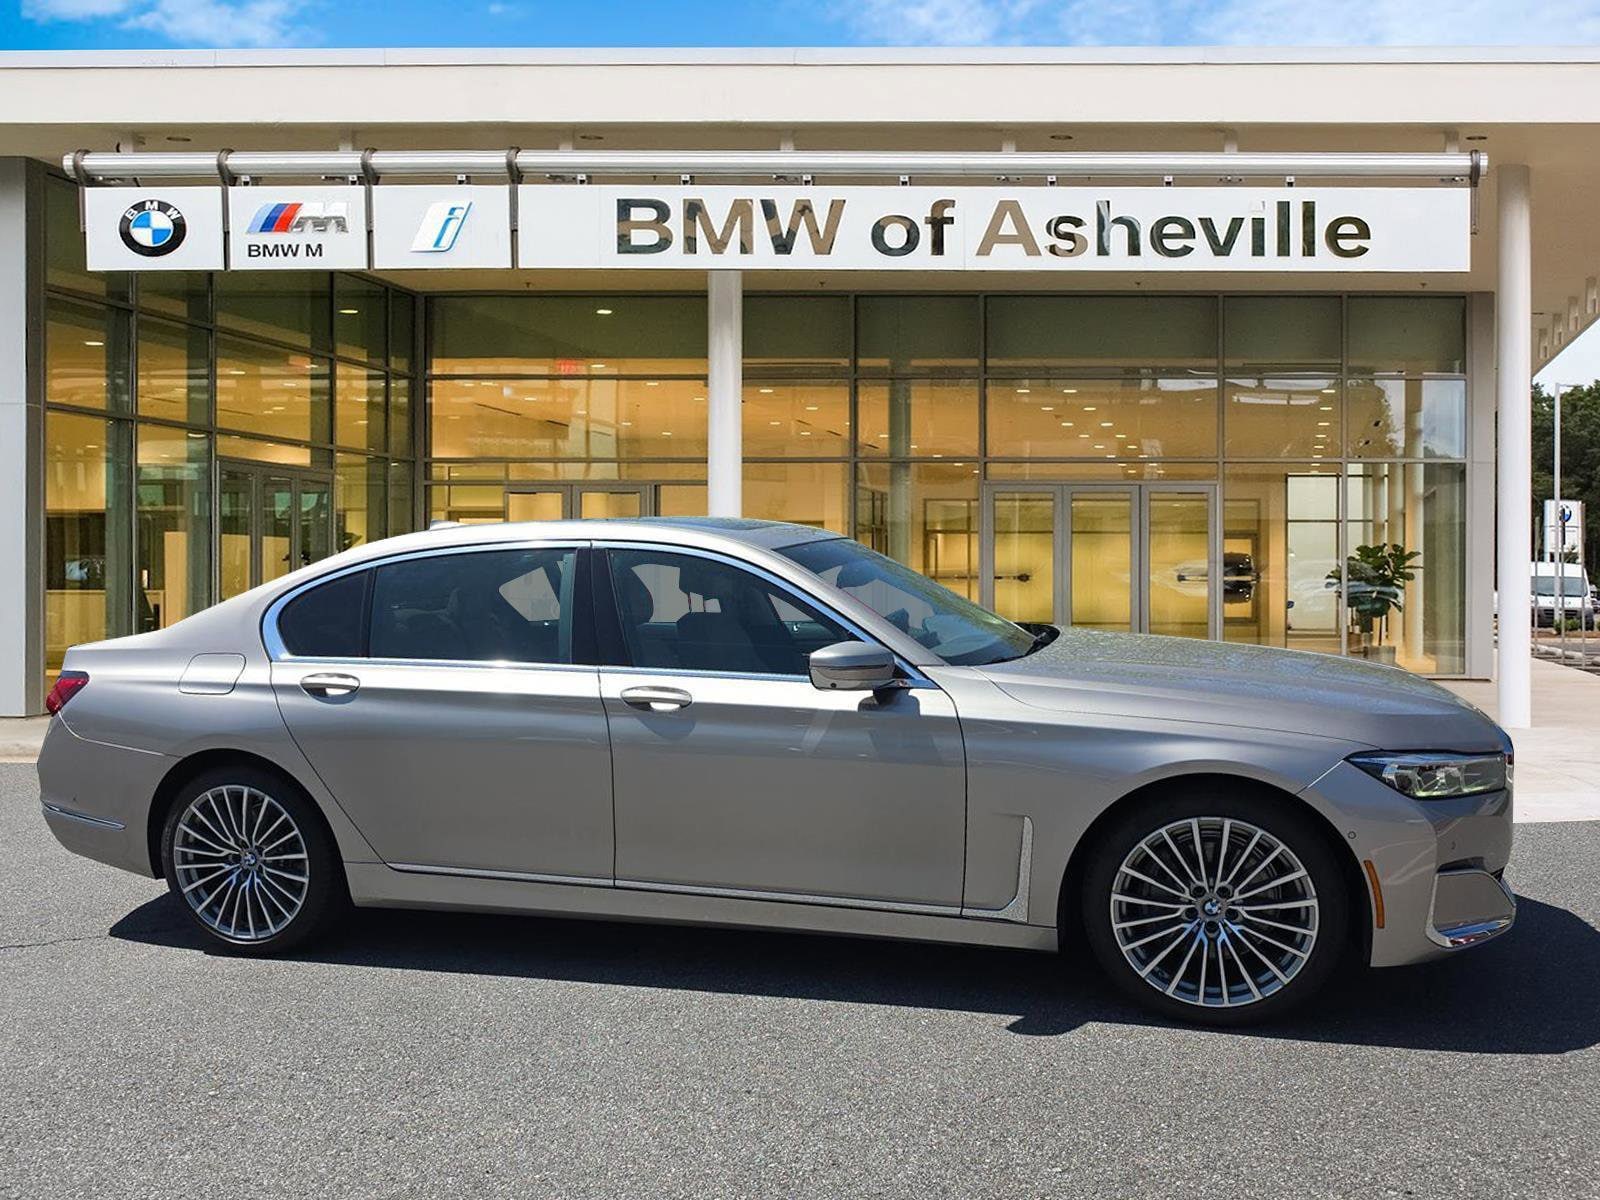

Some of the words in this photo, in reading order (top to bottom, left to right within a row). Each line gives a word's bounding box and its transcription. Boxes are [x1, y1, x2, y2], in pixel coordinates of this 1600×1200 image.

[125, 200, 181, 220] BMW
[432, 206, 465, 249] i
[616, 198, 846, 256] BMW
[870, 199, 956, 257] of
[975, 199, 1373, 259] Asheville
[247, 243, 300, 258] BMW
[305, 243, 323, 258] M
